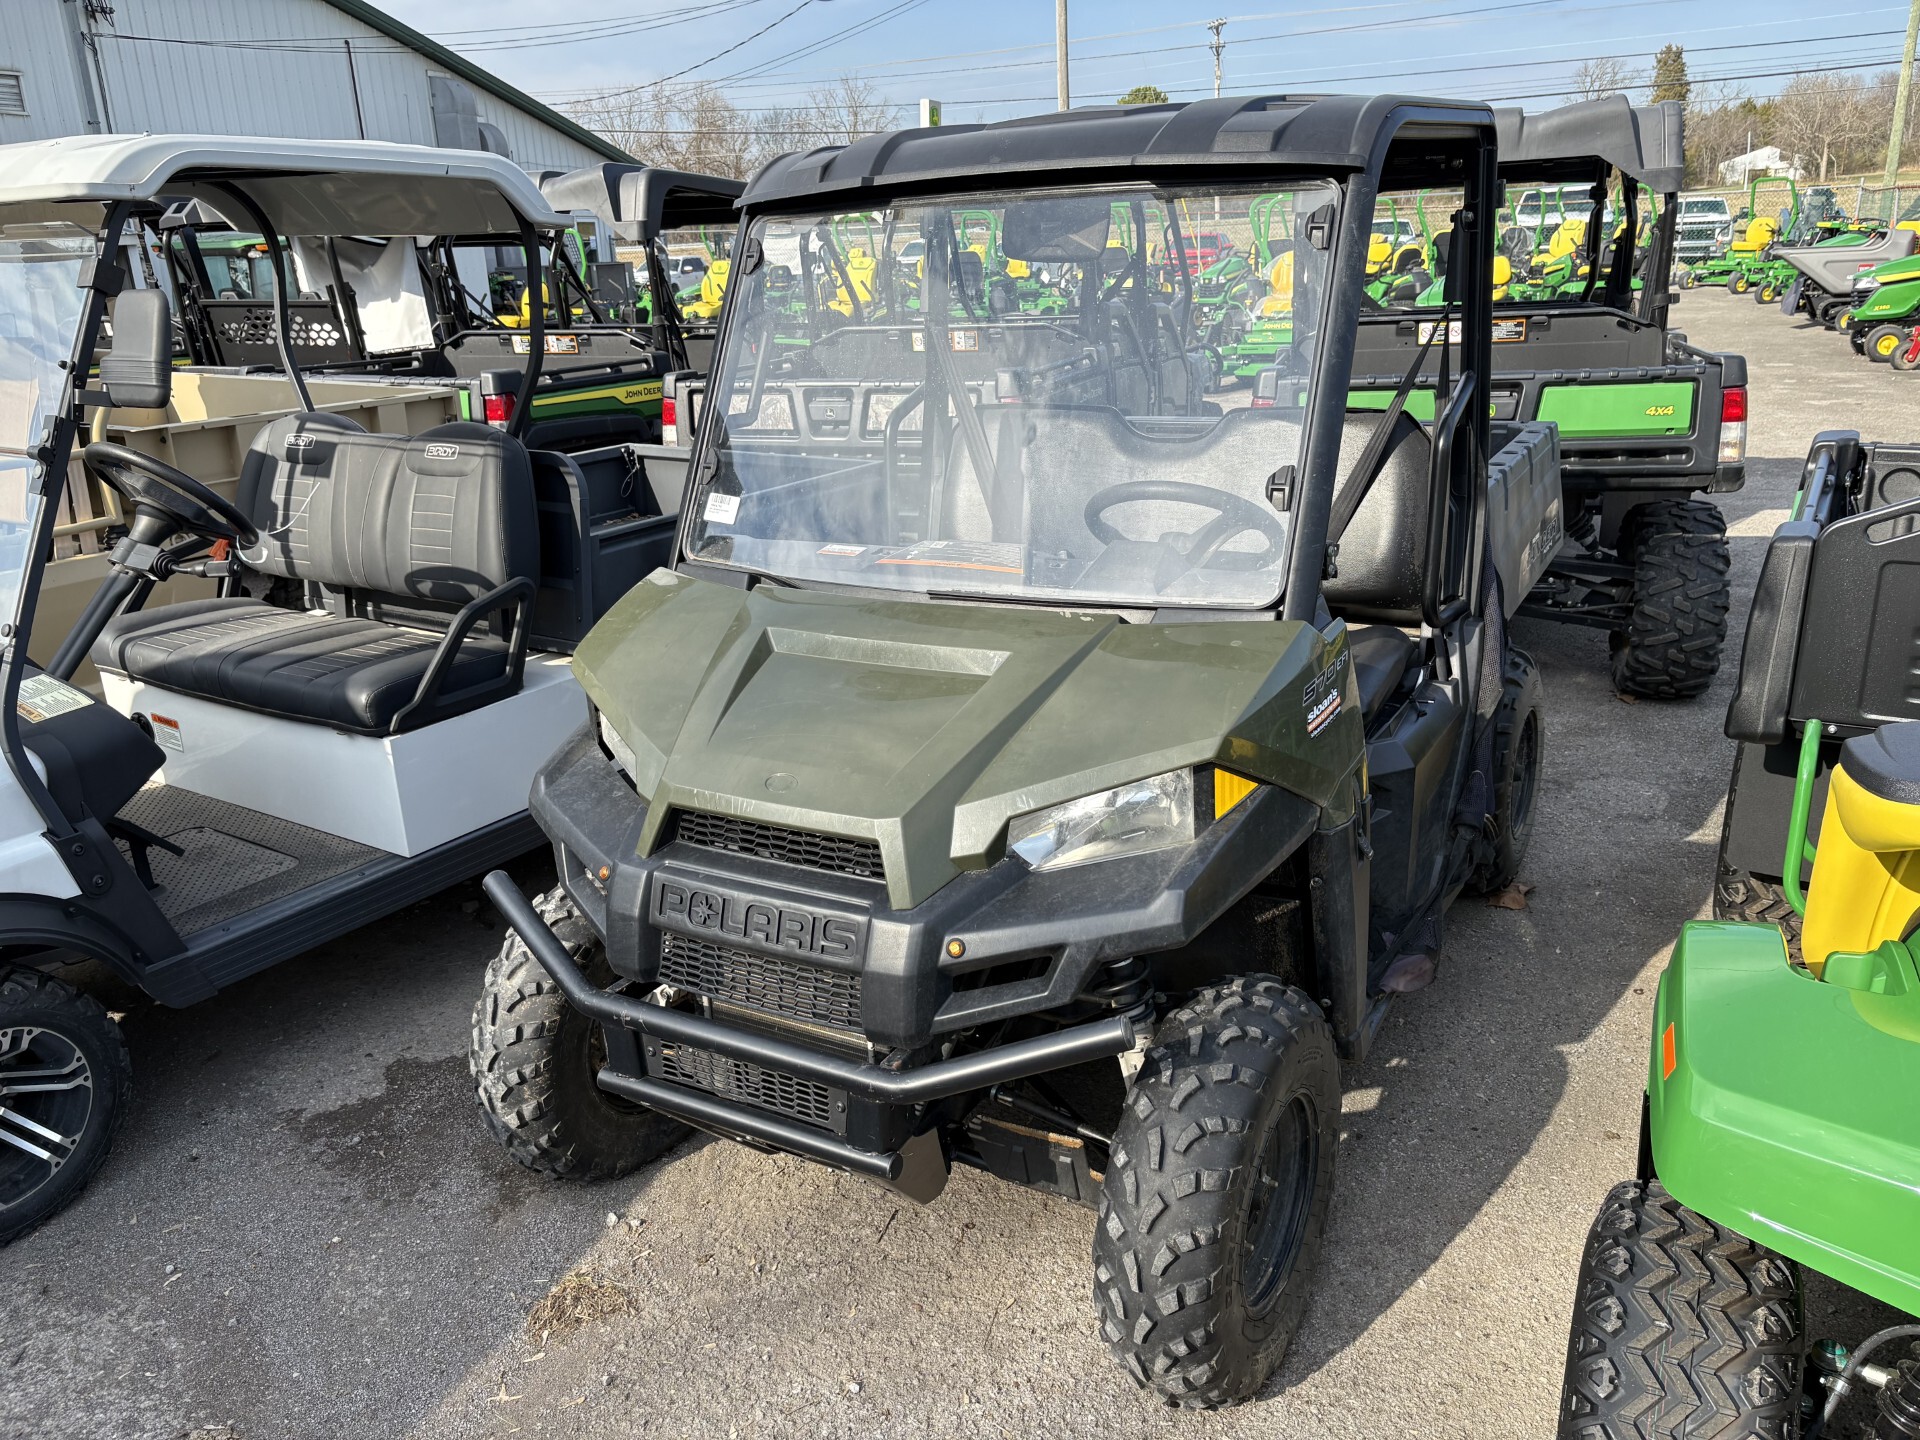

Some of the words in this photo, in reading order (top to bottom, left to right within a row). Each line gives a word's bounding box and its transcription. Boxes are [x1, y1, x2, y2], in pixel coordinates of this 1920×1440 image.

[624, 389, 643, 399] JOHN
[643, 386, 663, 396] DEER
[286, 436, 312, 447] BIRDY
[427, 446, 456, 457] BIRDY
[1302, 659, 1337, 706] 570
[1336, 649, 1349, 671] EFI
[1307, 688, 1338, 723] sloan's
[658, 883, 858, 961] POLARIS
